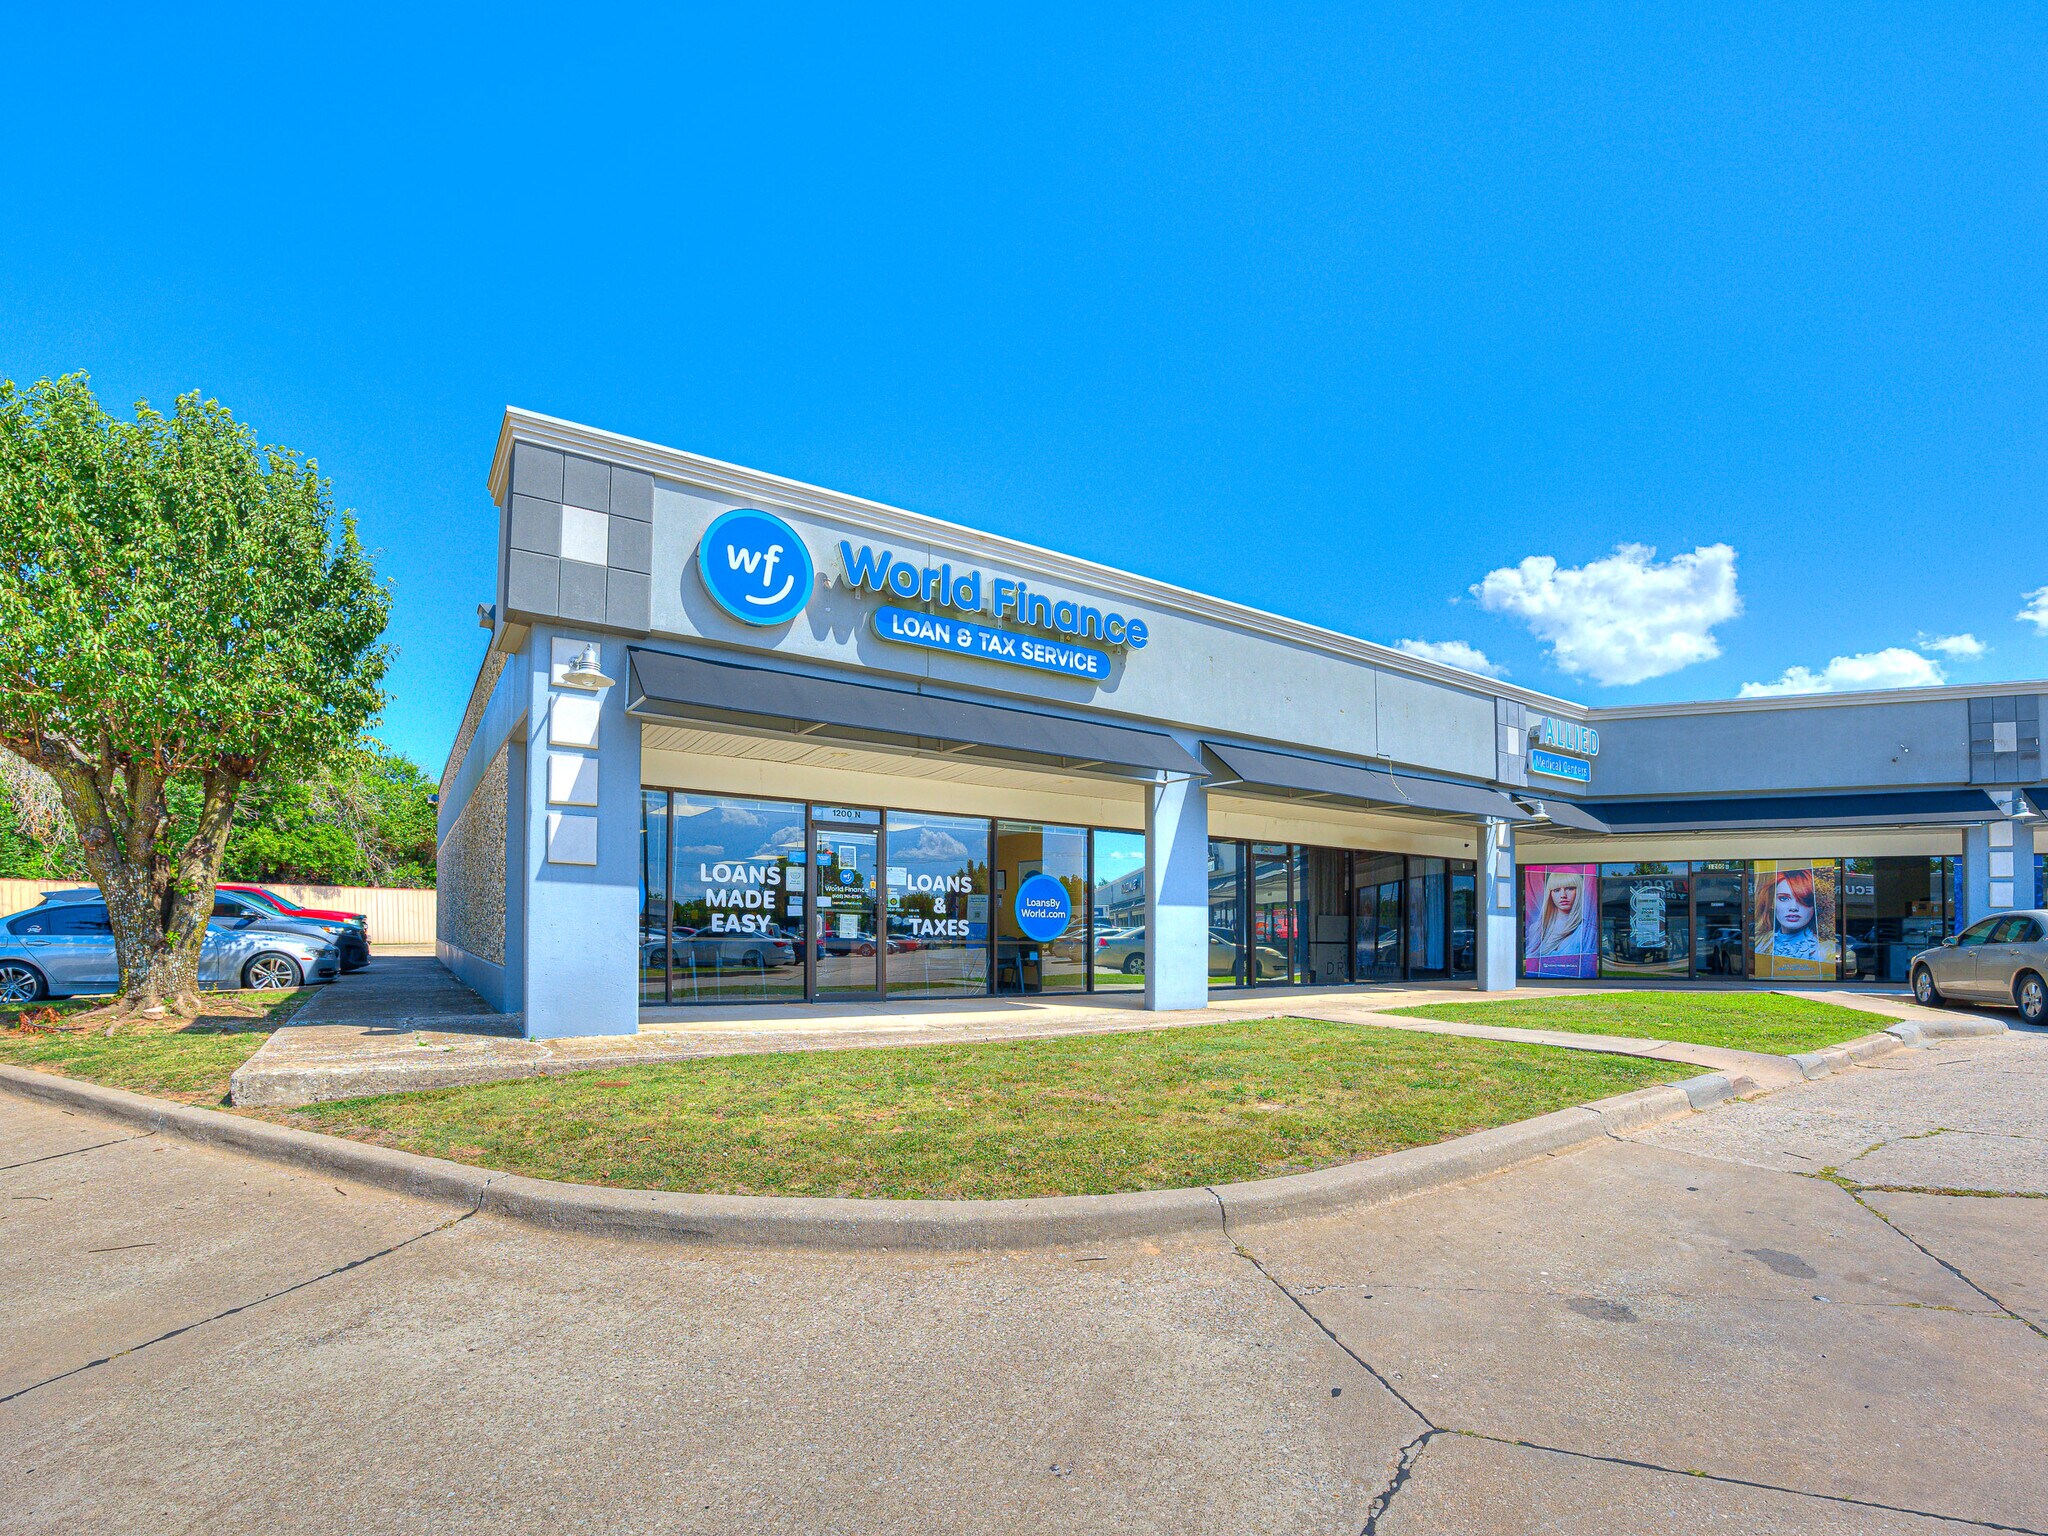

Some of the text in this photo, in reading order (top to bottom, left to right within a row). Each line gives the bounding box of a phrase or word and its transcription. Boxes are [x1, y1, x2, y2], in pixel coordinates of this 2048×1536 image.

[727, 544, 784, 587] wf
[838, 540, 1149, 650] World Finance
[892, 614, 1098, 673] LOAN & TAX SERVICE
[1544, 716, 1599, 756] ALLIED
[1535, 755, 1587, 777] Medical Centers
[832, 809, 852, 818] 1200
[700, 863, 781, 885] LOANS
[907, 873, 973, 893] LOANS
[705, 888, 776, 909] MADE
[933, 897, 947, 914] &
[1026, 897, 1061, 909] LoansBy
[711, 913, 771, 933] EASY
[1021, 909, 1066, 919] World.com
[908, 918, 970, 936] TAXES
